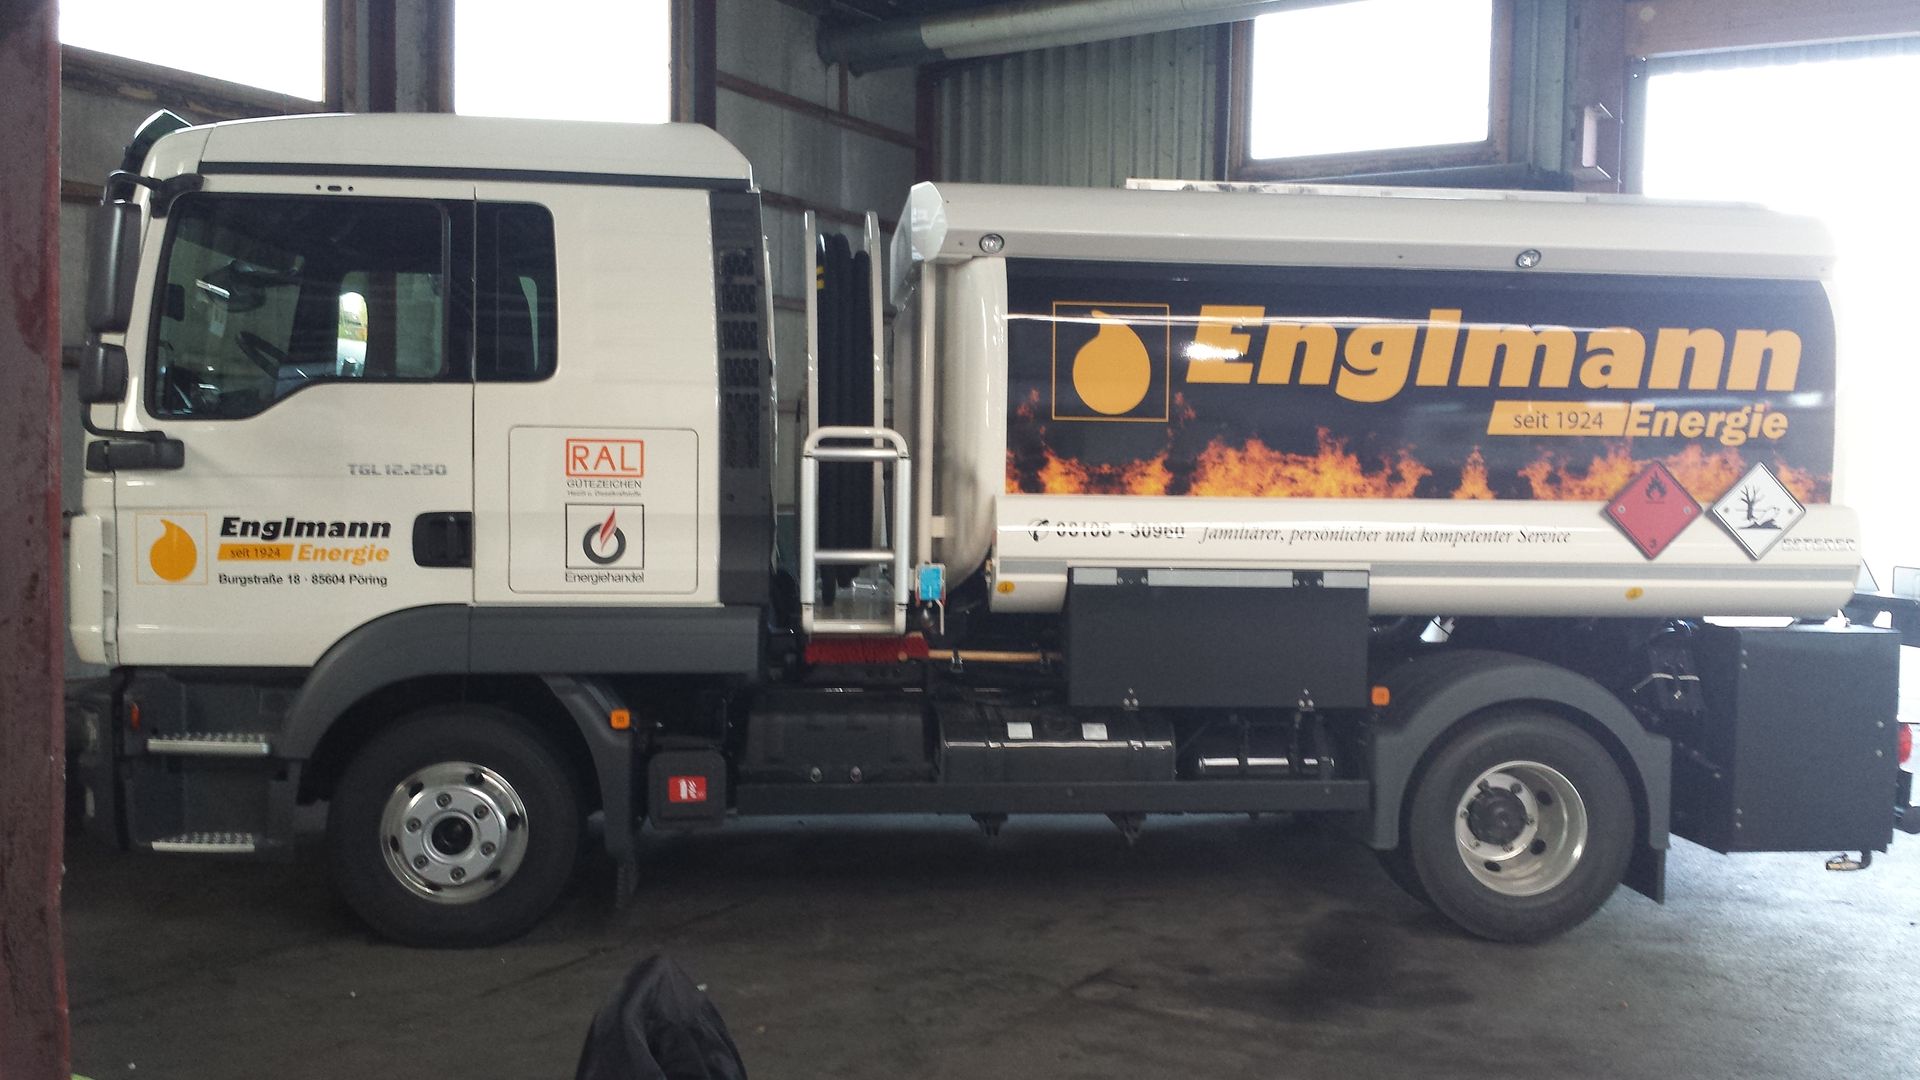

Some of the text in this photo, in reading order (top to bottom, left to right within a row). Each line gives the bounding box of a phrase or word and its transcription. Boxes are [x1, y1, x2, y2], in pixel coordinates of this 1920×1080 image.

[1186, 304, 1802, 403] Englmann
[1513, 409, 1604, 430] seit 1924
[1625, 403, 1789, 446] Energie
[572, 445, 638, 472] RAL
[566, 479, 642, 489] GÜTEZEICHEN
[220, 517, 391, 541] Englmann
[230, 548, 280, 559] seit 1924
[298, 544, 390, 565] Energie
[218, 573, 388, 587] Burgstraße 18 85604 Pöring
[565, 573, 644, 585] Energiehandel
